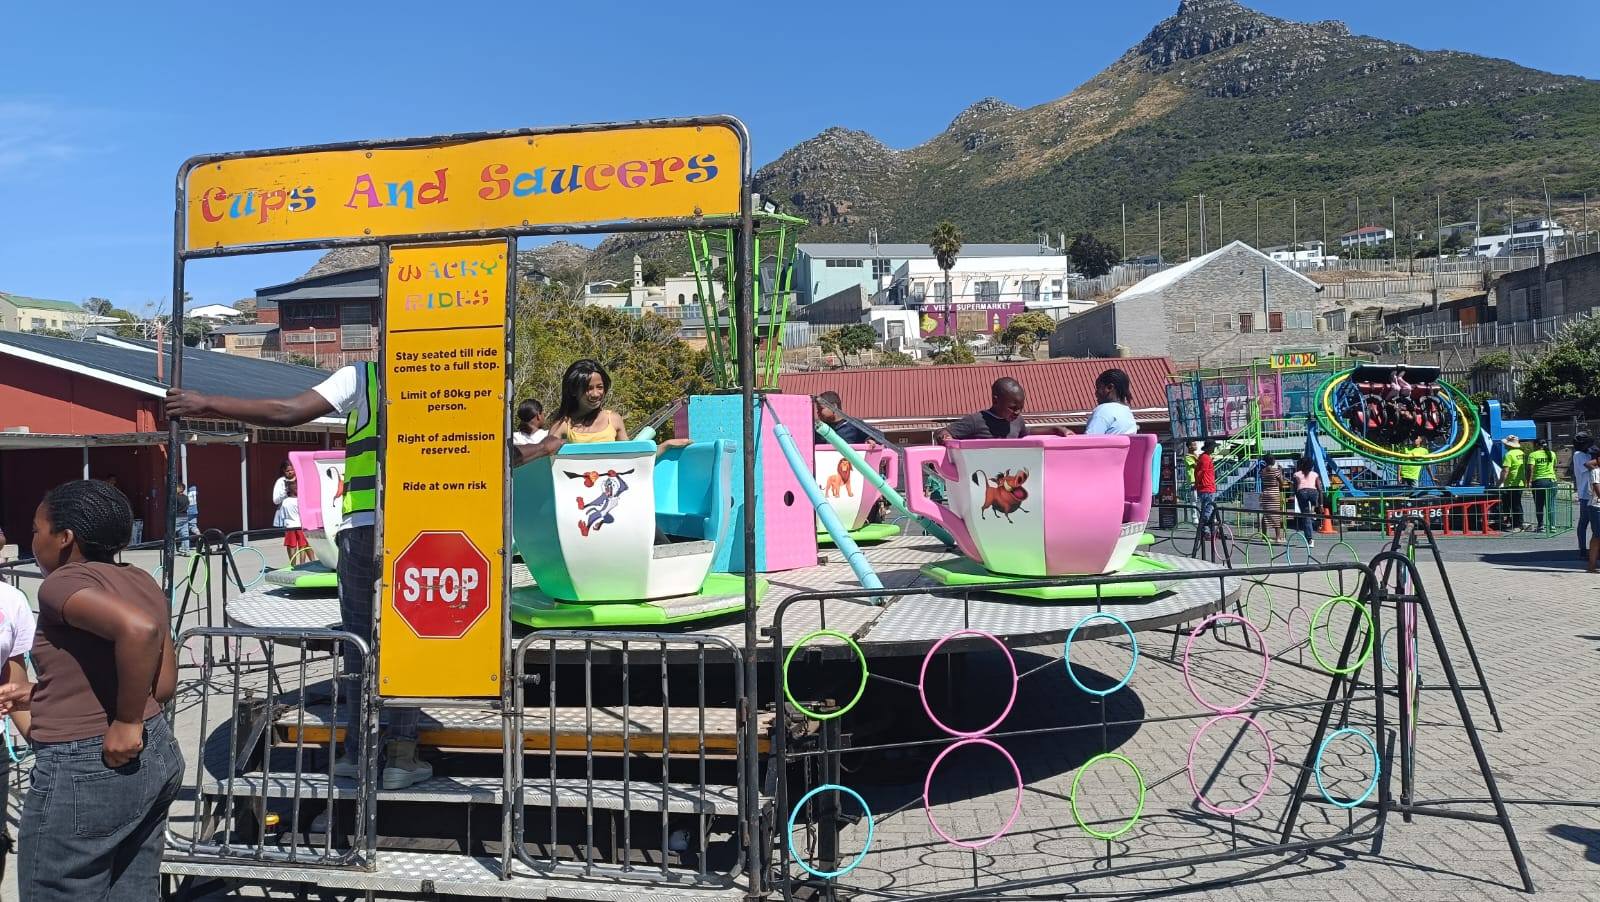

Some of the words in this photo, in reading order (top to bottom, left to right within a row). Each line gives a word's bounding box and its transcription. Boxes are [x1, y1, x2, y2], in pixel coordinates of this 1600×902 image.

[201, 186, 317, 225] Cups
[344, 168, 449, 210] And
[478, 153, 719, 201] Saucers
[397, 260, 498, 282] WACKY
[956, 302, 1012, 311] SUPERMARKET
[395, 351, 419, 362] Stay
[422, 349, 457, 360] seated
[460, 348, 474, 358] till
[477, 347, 498, 357] ride
[1270, 352, 1316, 367] TORNADO
[393, 363, 427, 373] comes
[430, 362, 441, 372] to
[453, 361, 470, 370] full
[473, 360, 500, 371] stop.
[400, 390, 427, 400] Limit
[430, 389, 441, 399] of
[443, 389, 471, 399] 80kg
[474, 388, 492, 398] per
[427, 403, 467, 413] person.
[397, 433, 426, 444] Right
[428, 432, 440, 442] of
[442, 432, 495, 442] admission
[421, 444, 471, 455] reserved.
[402, 482, 426, 491] Ride
[429, 481, 440, 491] at
[442, 482, 465, 490] own
[467, 480, 487, 490] risk
[403, 567, 479, 602] STOP
